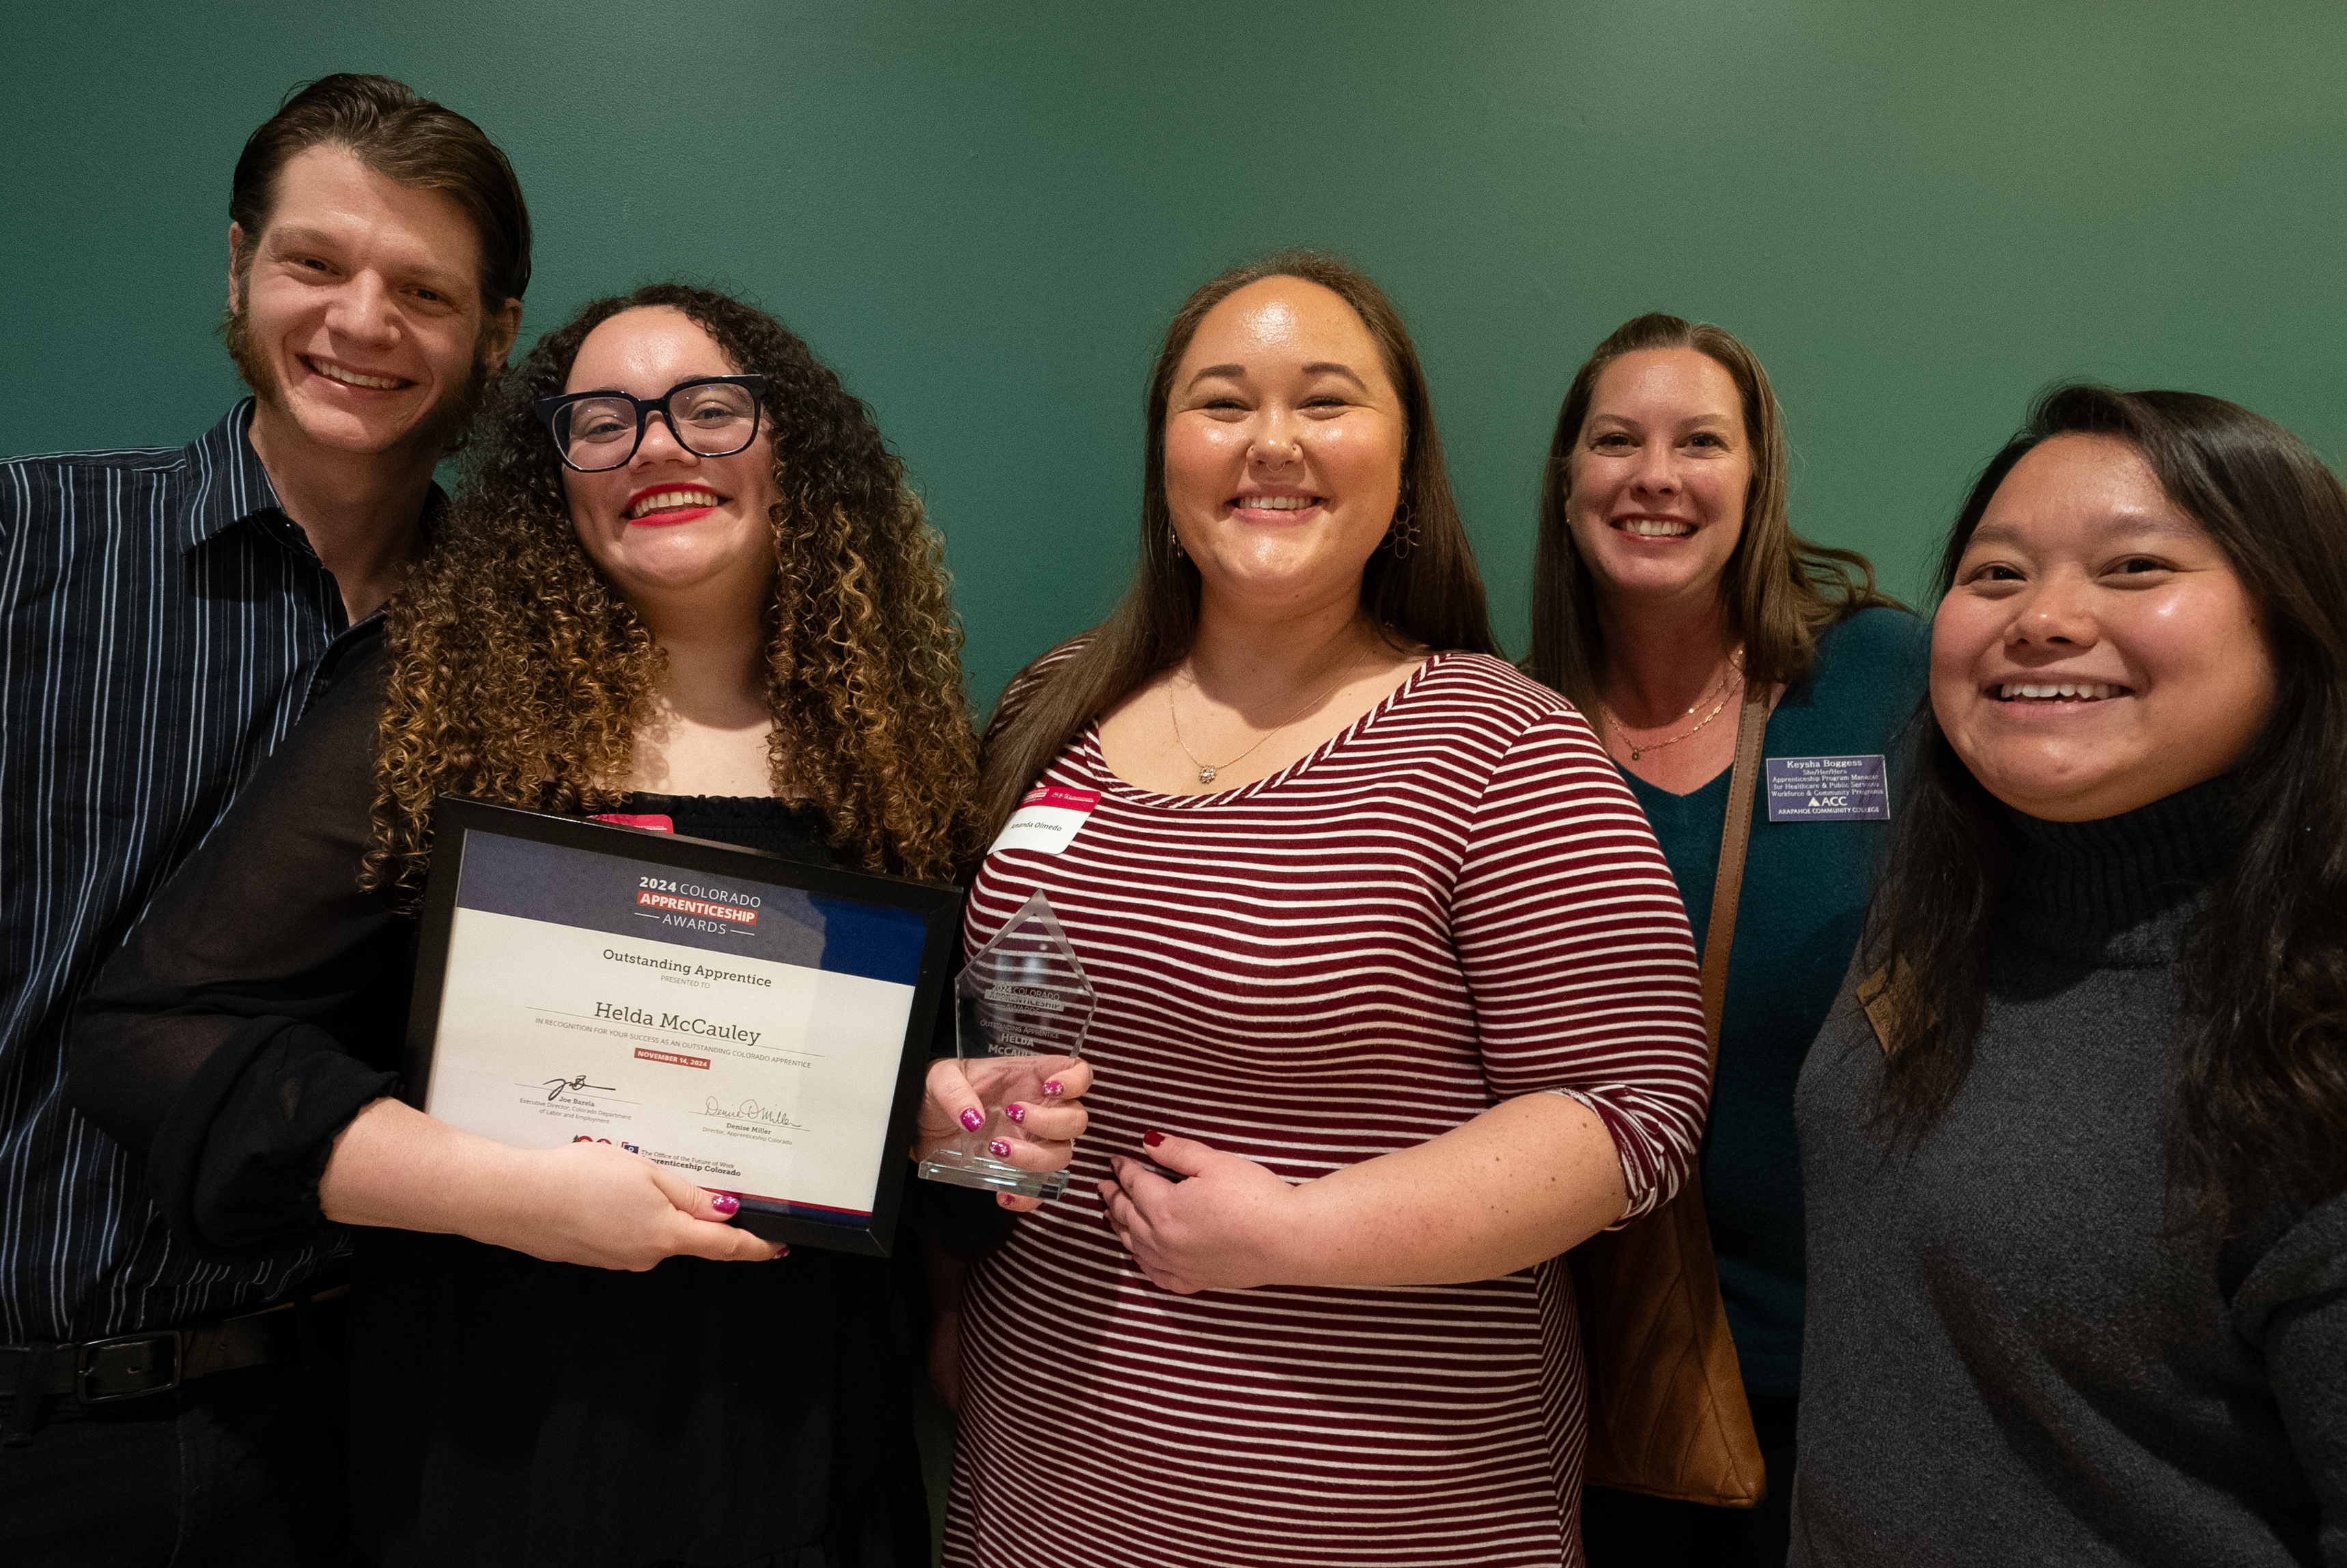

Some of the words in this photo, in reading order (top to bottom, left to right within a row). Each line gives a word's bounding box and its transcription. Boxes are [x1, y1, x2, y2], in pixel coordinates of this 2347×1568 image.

[1787, 760, 1821, 769] Keysha
[1823, 759, 1863, 768] Boggess
[1821, 797, 1848, 807] ACC
[1035, 822, 1062, 831] Olmedo
[639, 876, 677, 893] 2024
[679, 884, 761, 908] COLORADO
[640, 893, 755, 923] APPRENTICESHIP
[662, 914, 727, 934] AWARDS
[603, 949, 692, 975] Outstanding
[694, 965, 772, 987] Apprentice
[660, 975, 699, 987] PRESENTED
[993, 983, 1012, 993] 2024
[1013, 987, 1060, 1000] COLORADO
[989, 992, 1060, 1009] APPRENTICESHIP
[1005, 1004, 1041, 1015] AWARDS
[595, 1001, 653, 1026] Helda
[660, 1013, 761, 1046] McCauley
[544, 1019, 592, 1032] RECOGNITION
[609, 1030, 628, 1038] YOUR
[630, 1033, 659, 1044] SUCCESS
[682, 1042, 731, 1055] OUTSTANDING
[733, 1050, 770, 1062] COLORADO
[771, 1057, 811, 1069] APPRENTICE
[637, 1050, 677, 1063] NOVEMBER
[690, 1059, 707, 1067] 2024
[520, 1098, 546, 1107] Executive
[547, 1102, 571, 1111] Director,
[572, 1106, 597, 1115] Colorado
[598, 1110, 632, 1120] Department
[573, 1098, 595, 1107] Barela
[576, 1115, 610, 1124] Employment
[703, 1127, 725, 1136] Director,
[727, 1131, 766, 1142] Apprenticeship
[768, 1136, 793, 1145] Colorado
[727, 1123, 750, 1132] Denise
[751, 1127, 772, 1135] Miller
[653, 1151, 672, 1160] Office
[720, 1161, 735, 1169] Work
[704, 1165, 741, 1177] Colorado
